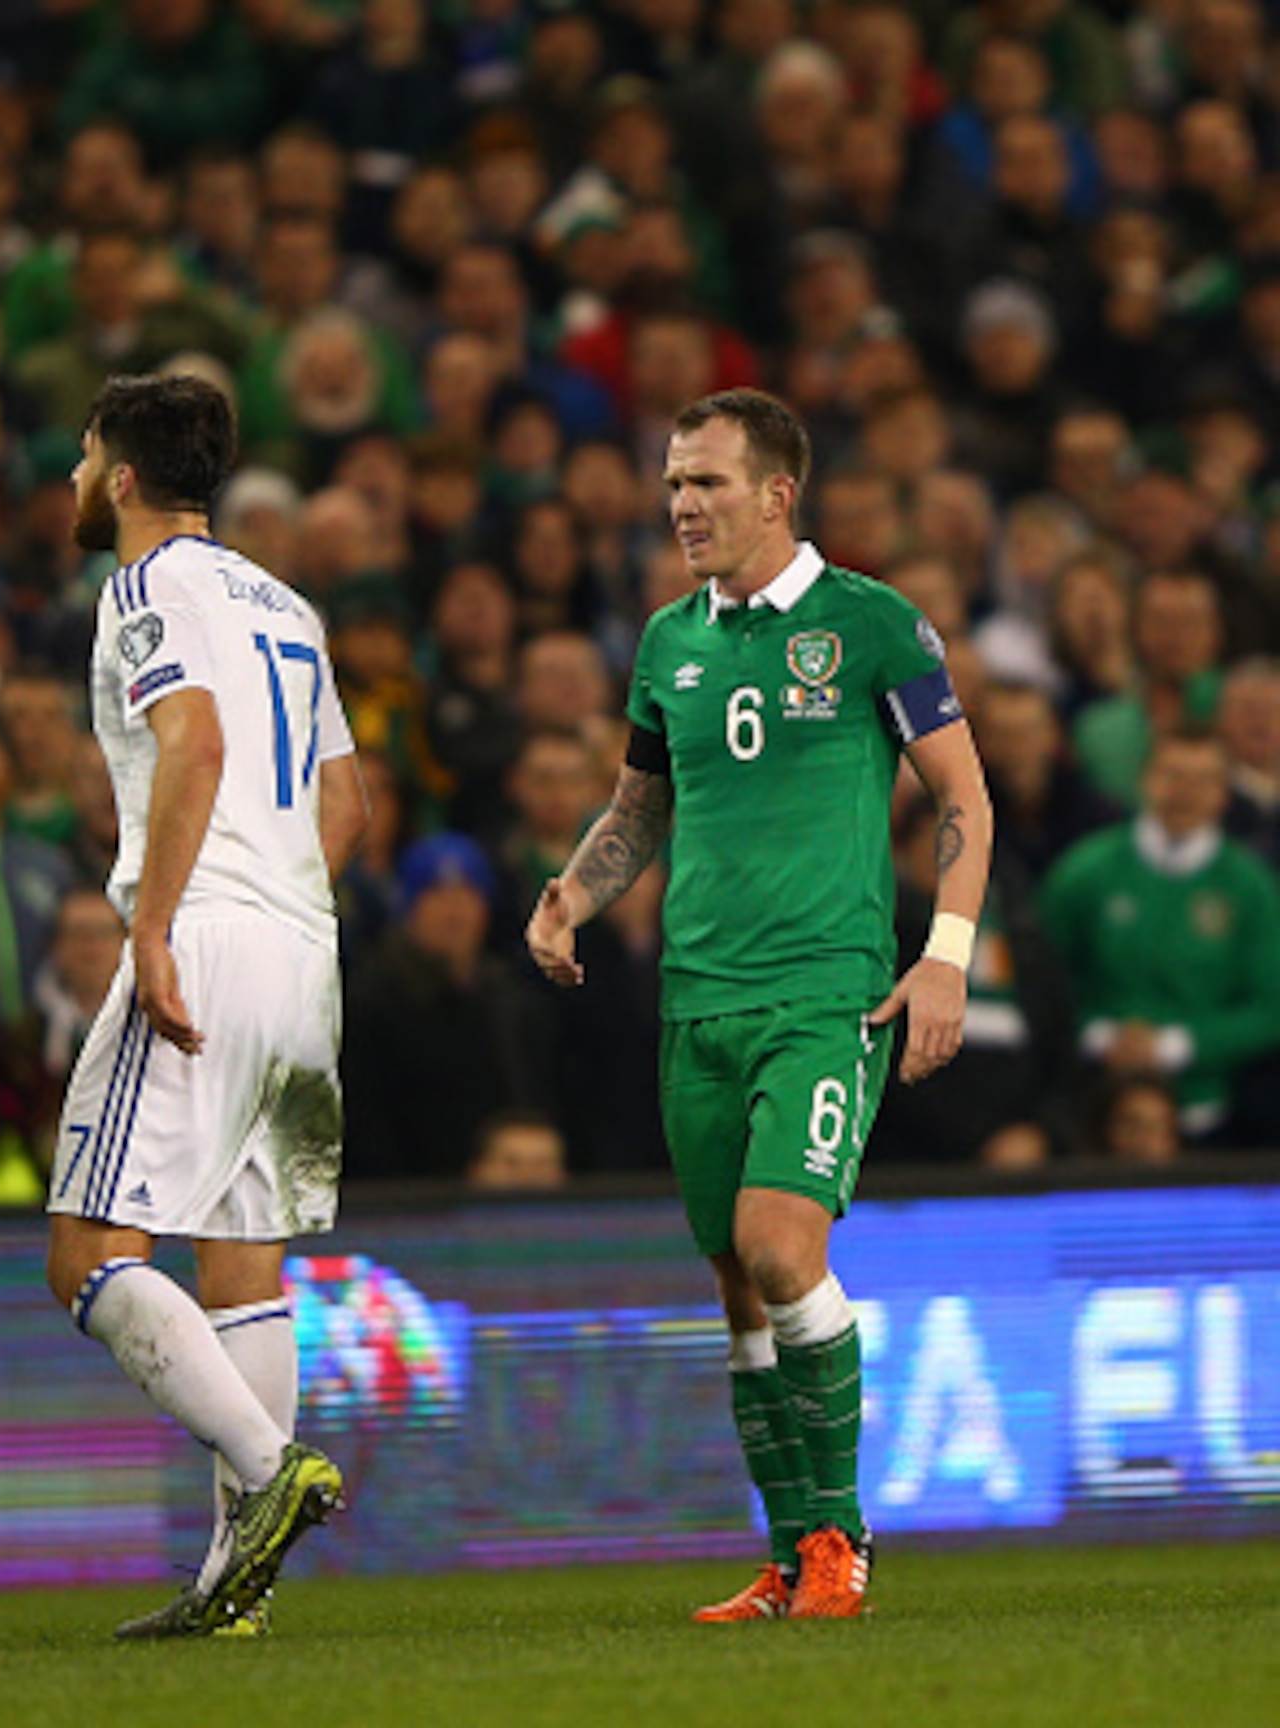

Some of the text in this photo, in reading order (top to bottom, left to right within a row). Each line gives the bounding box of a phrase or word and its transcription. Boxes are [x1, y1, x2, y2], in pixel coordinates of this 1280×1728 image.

[252, 633, 321, 809] 17
[726, 686, 765, 761] 6
[808, 1076, 847, 1151] 6
[57, 1125, 91, 1198] 7
